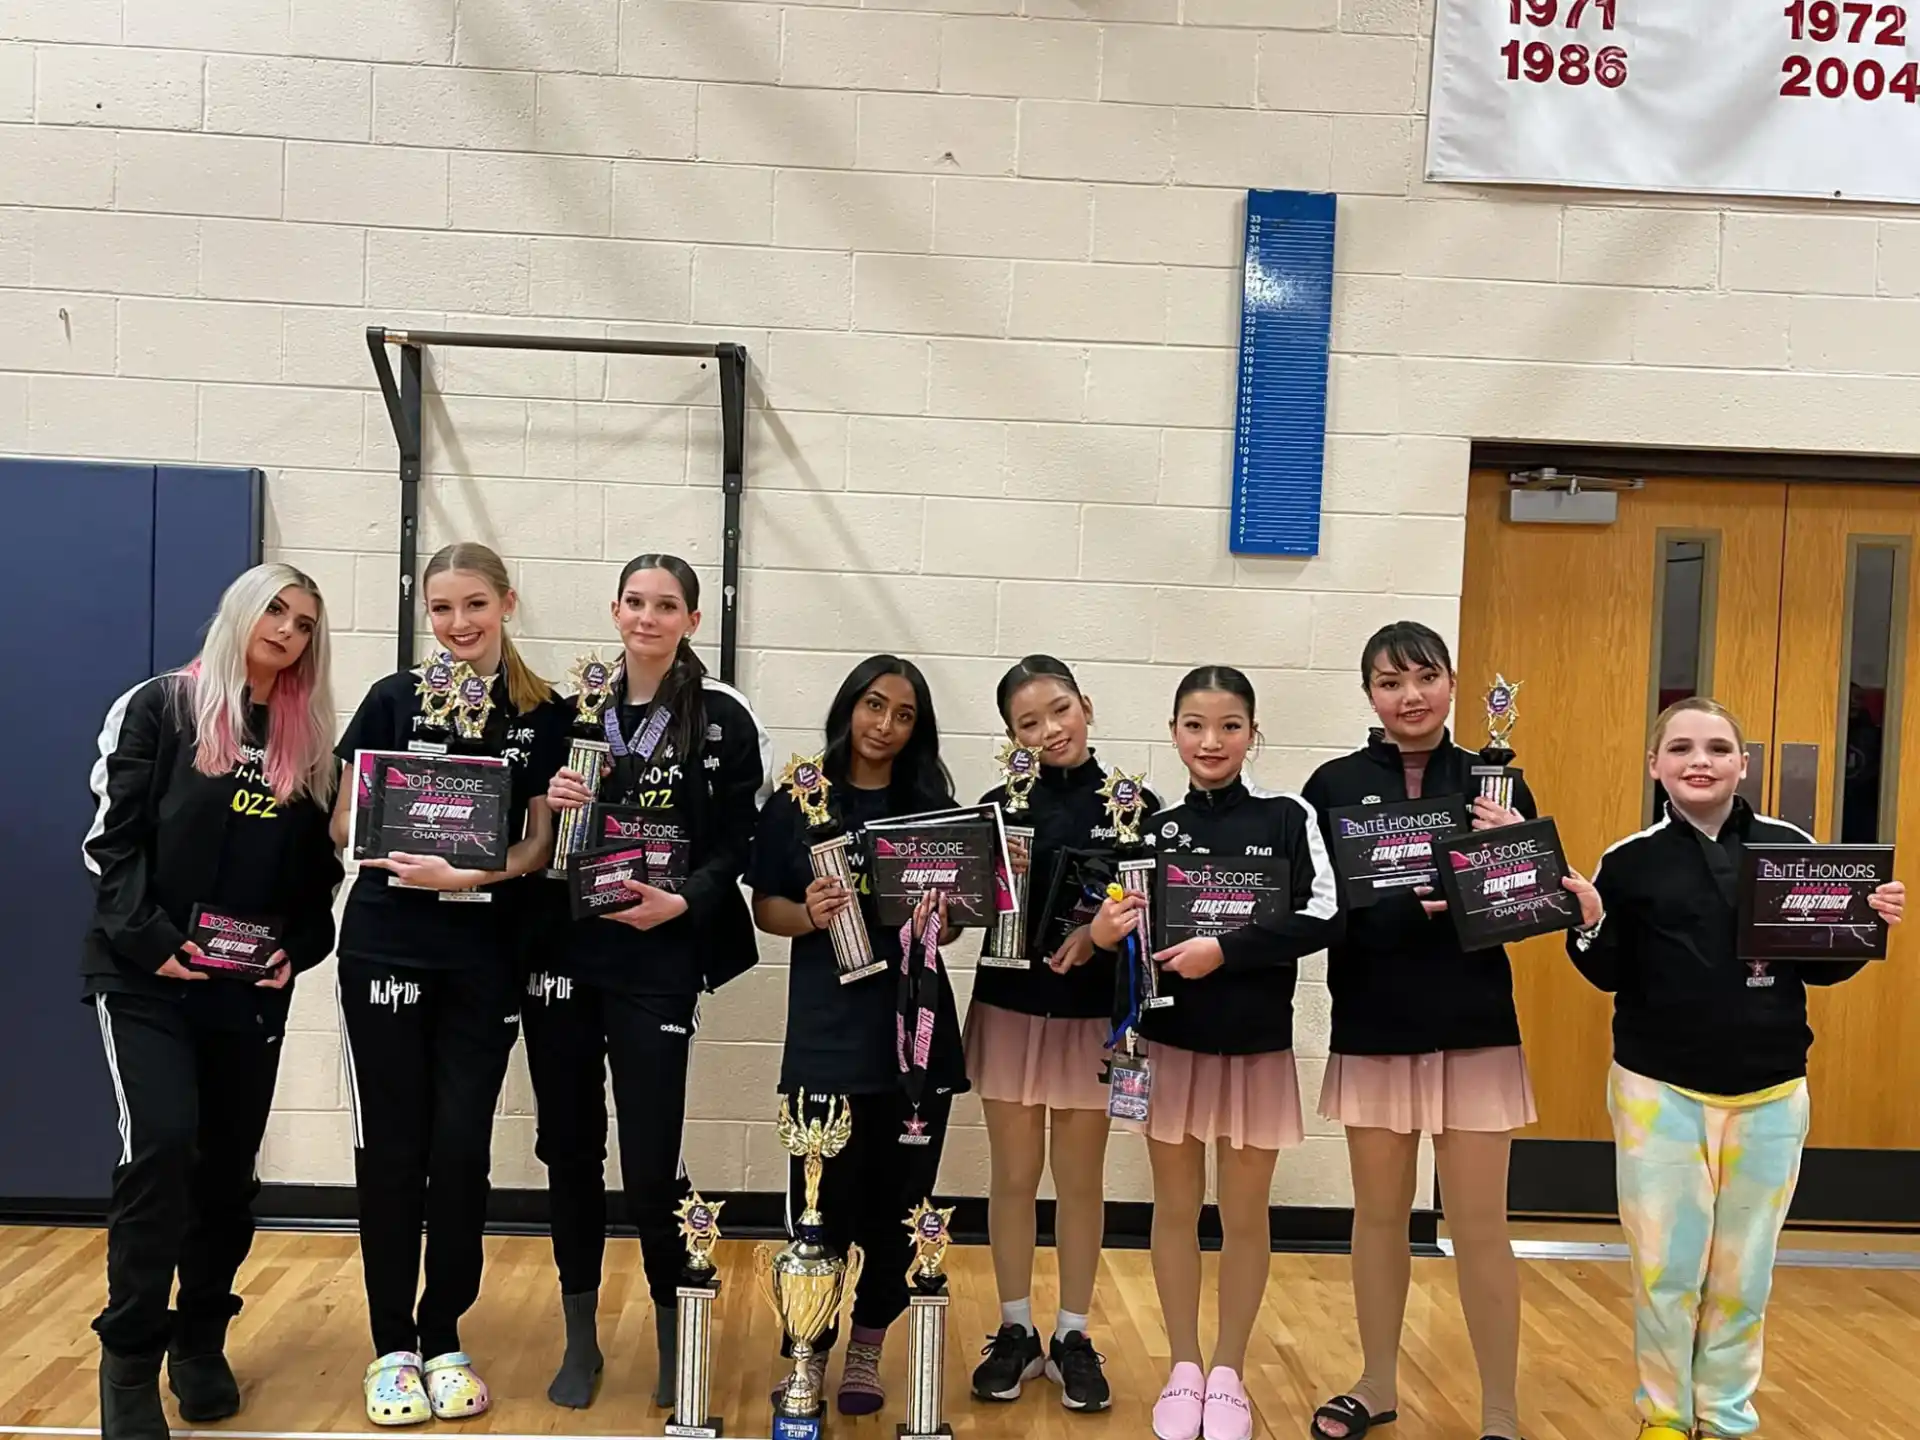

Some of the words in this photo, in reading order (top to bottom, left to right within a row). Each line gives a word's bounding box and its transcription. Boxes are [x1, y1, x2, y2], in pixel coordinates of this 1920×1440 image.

[1507, 0, 1616, 30] 1971
[1784, 0, 1907, 46] 1972
[1500, 40, 1627, 88] 1986
[1779, 55, 1920, 103] 2004
[1250, 215, 1261, 223] 33
[1250, 225, 1260, 233] 32
[1250, 235, 1259, 243] 31
[1245, 316, 1256, 324] 23
[1245, 326, 1256, 334] 22
[1244, 336, 1254, 344] 21
[1244, 346, 1254, 354] 20
[1244, 356, 1254, 364] 19
[1243, 366, 1253, 374] 18
[1243, 376, 1252, 384] 17
[1242, 396, 1252, 404] 15
[1241, 406, 1251, 414] 14
[1241, 416, 1250, 424] 13
[1239, 447, 1249, 455] 10
[405, 774, 432, 788] TOP
[435, 776, 484, 792] SCORE
[620, 821, 640, 836] TOP
[643, 824, 679, 838] SCORE
[1347, 819, 1385, 835] ELITE
[1389, 811, 1451, 830] HONORS
[412, 831, 468, 842] CHAMPION
[894, 842, 917, 855] TOP
[920, 842, 964, 855] SCORE
[1466, 849, 1491, 866] TOP
[1494, 839, 1538, 860] SCORE
[900, 869, 959, 882] STARSTRUCK
[1764, 864, 1805, 878] ELITE
[1809, 864, 1875, 878] HONORS
[1184, 870, 1212, 885] TOP
[1215, 872, 1264, 886] SCORE
[1190, 900, 1257, 914] STARSTRUCK
[1494, 898, 1543, 918] CHAMPION
[1781, 895, 1853, 909] STARSTRUCK
[208, 916, 230, 929] TOP
[232, 920, 271, 937] SCORE
[1207, 1393, 1249, 1412] AUTICA
